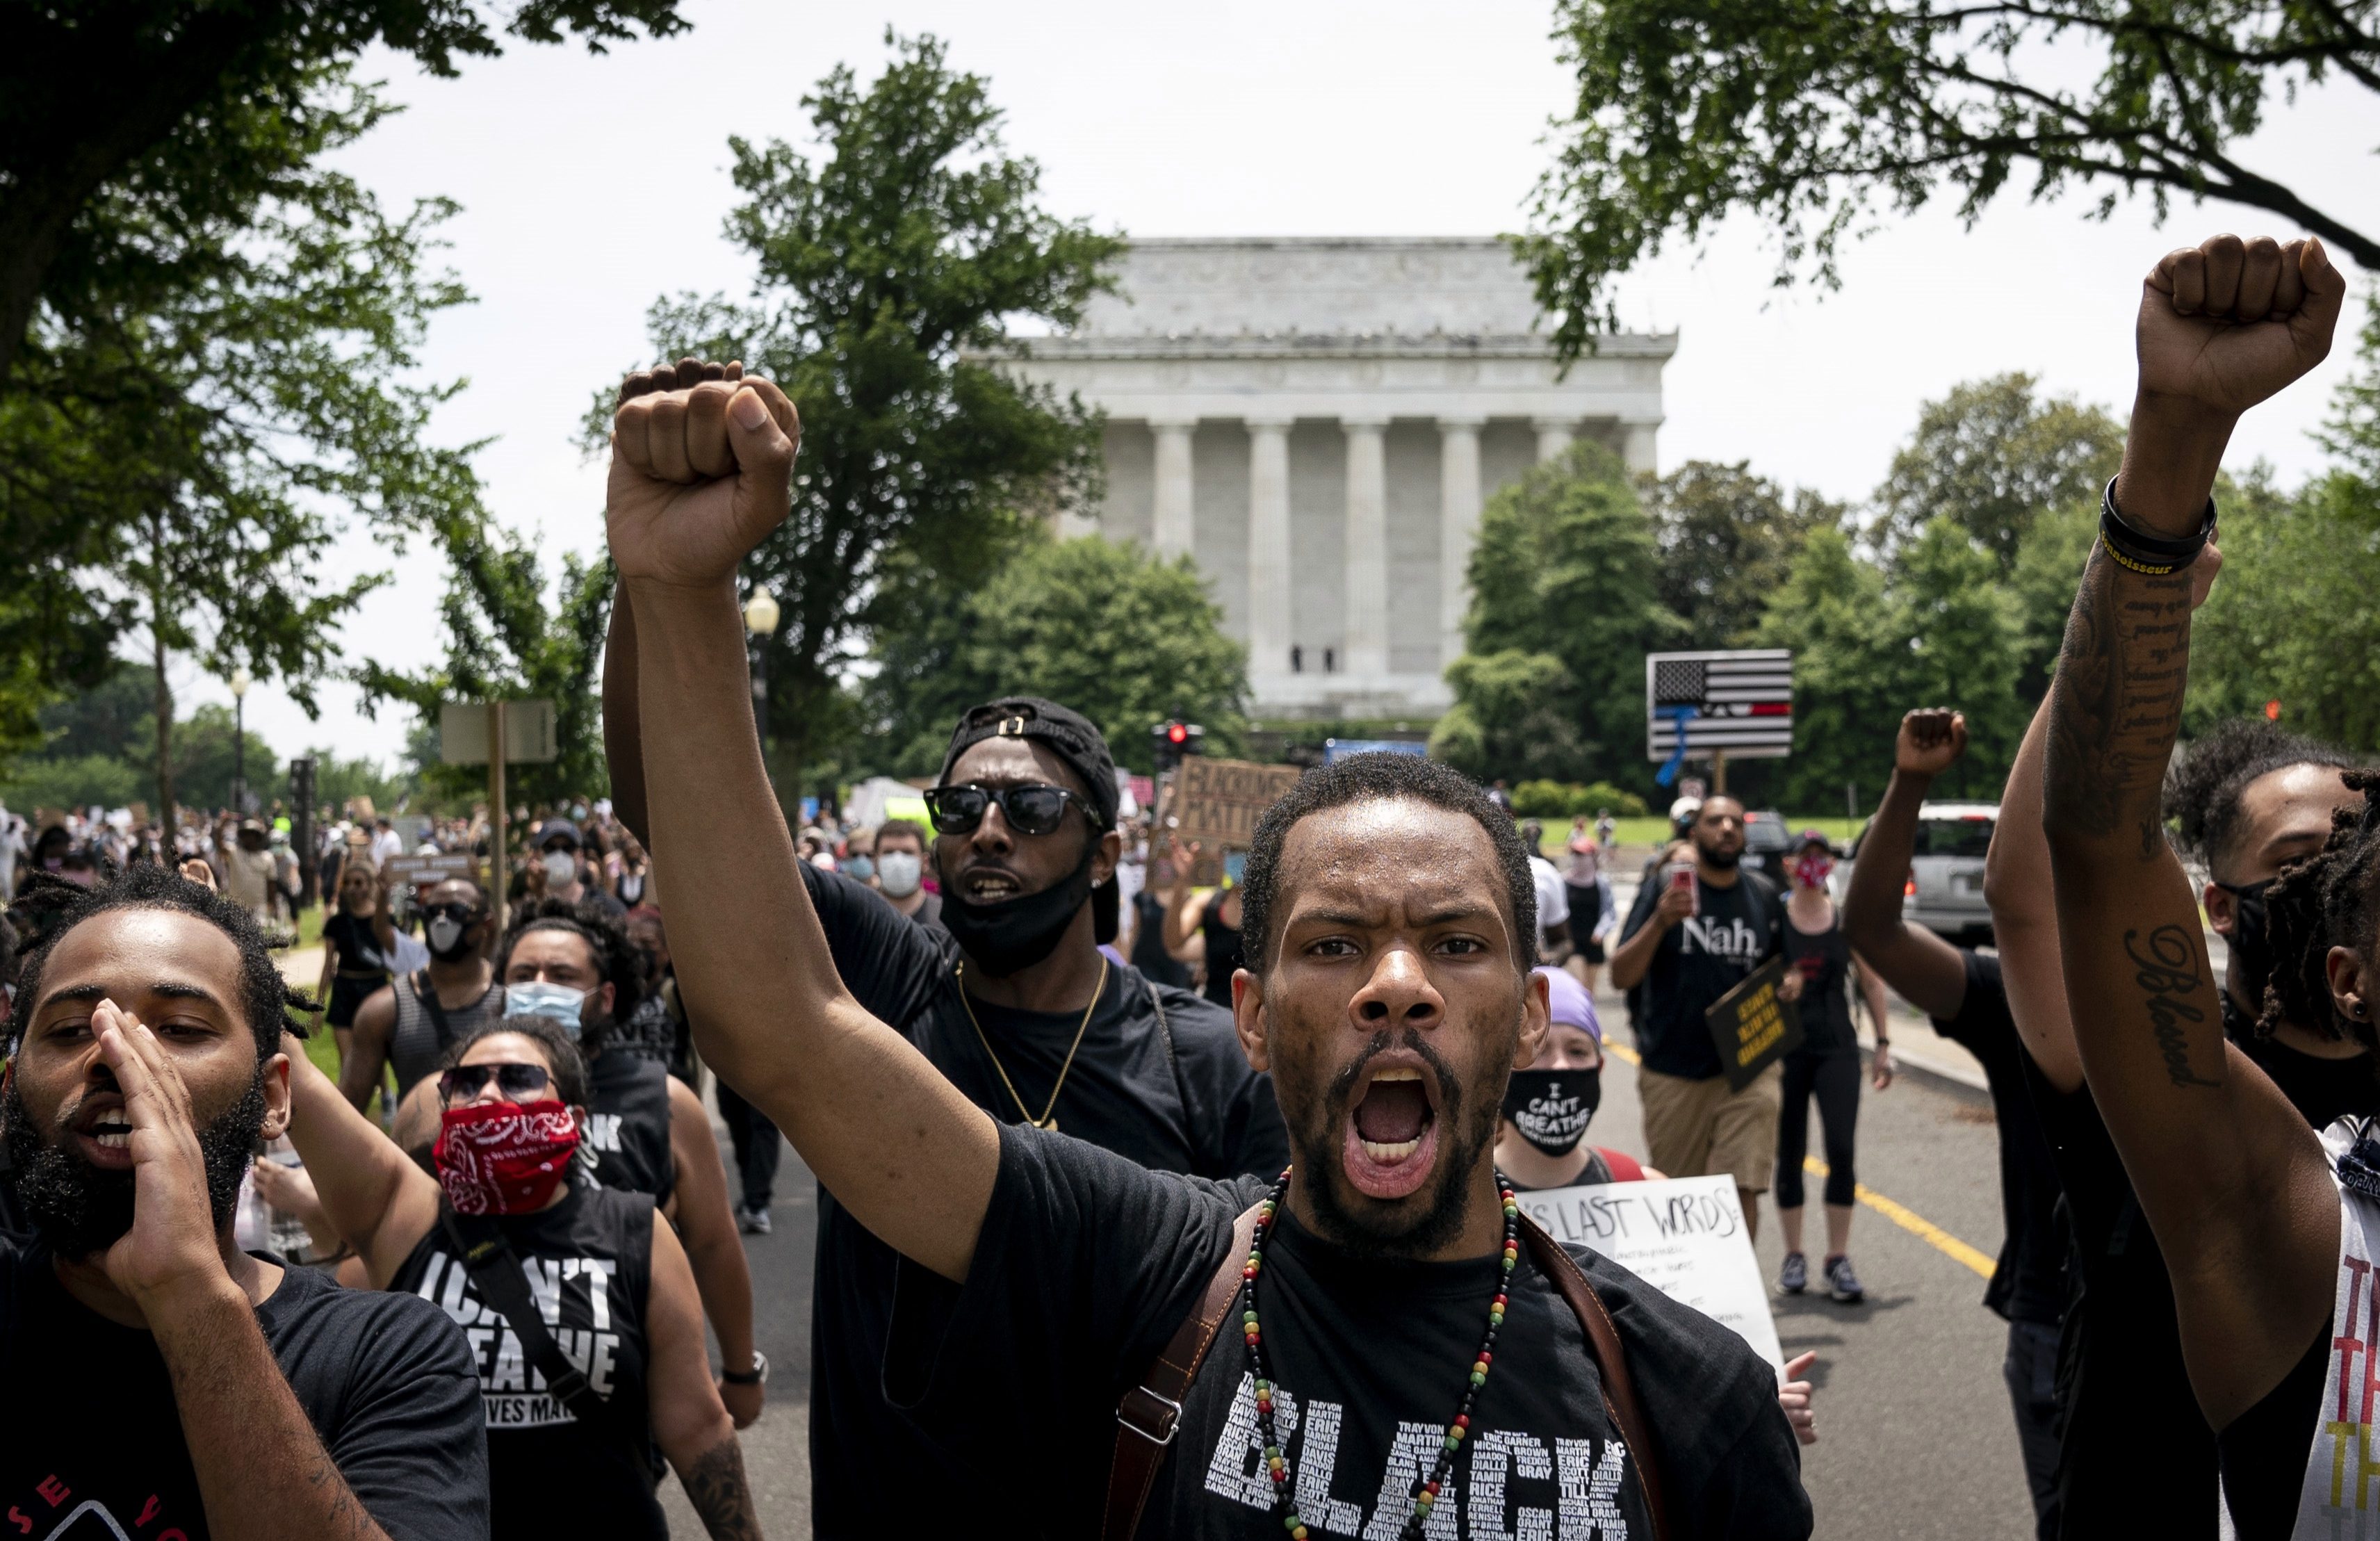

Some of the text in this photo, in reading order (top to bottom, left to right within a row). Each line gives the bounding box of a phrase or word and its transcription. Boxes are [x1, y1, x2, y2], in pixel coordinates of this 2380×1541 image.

[1549, 1082, 1562, 1099] I
[1529, 1096, 1581, 1117] CAN'T
[1516, 1107, 1590, 1134] BREATHE
[1556, 1196, 1633, 1241] LAST
[1309, 1399, 1342, 1412] TRAYVON
[1228, 1412, 1256, 1431] TAMIR
[1307, 1408, 1342, 1421] MARTIN
[1223, 1422, 1250, 1444] RICE
[1305, 1417, 1341, 1435] ERIC
[1399, 1421, 1444, 1435] TRAYVON
[1304, 1429, 1339, 1444] GARNER
[1396, 1432, 1445, 1448] MARTIN
[1483, 1432, 1502, 1443] ERIC
[1503, 1436, 1541, 1448] GARNER
[1555, 1437, 1590, 1448] TRAYVON
[1218, 1435, 1249, 1454] OSCAR
[1303, 1437, 1337, 1453] JORDAN
[1393, 1440, 1412, 1453] ERIC
[1474, 1440, 1549, 1458] MICHAEL BROWN
[1556, 1445, 1590, 1457] MARTIN
[1213, 1452, 1245, 1471] TRAYVON
[1216, 1445, 1248, 1463] GRANT
[1302, 1444, 1336, 1465] DAVIS
[1391, 1448, 1417, 1461] SANDRA
[1472, 1451, 1508, 1462] AMADOU
[1516, 1456, 1551, 1467] FREDDIE
[1209, 1460, 1242, 1479] MARTIN
[1387, 1456, 1416, 1469] BLAND
[1472, 1459, 1508, 1472] DIALLO
[1558, 1455, 1590, 1469] ERIC
[1298, 1462, 1332, 1482] DIALLO
[1386, 1466, 1418, 1480] KIMANI
[1469, 1470, 1506, 1484] TAMIR
[1517, 1464, 1553, 1481] GRAY
[1558, 1465, 1590, 1478] SCOTT
[1207, 1469, 1244, 1492] MICHAEL
[1246, 1484, 1279, 1504] BROWN
[1296, 1473, 1330, 1493] ERIC
[1384, 1475, 1414, 1490] GRAY
[1204, 1479, 1271, 1512] SANDRA BLAND
[1295, 1485, 1328, 1502] SCOTT
[1381, 1484, 1410, 1499] OSCAR
[1469, 1482, 1505, 1499] RICE
[1559, 1481, 1590, 1501] TILL
[1467, 1503, 1505, 1515] FERRELL
[1517, 1506, 1553, 1520] OSCAR
[1558, 1505, 1621, 1519] OSCAR GRANT
[1467, 1512, 1503, 1523] RENISHA
[1517, 1517, 1553, 1530] GRANT
[1558, 1515, 1627, 1530] TRAYVON TAMIR
[1326, 1519, 1359, 1538] GRANT
[1367, 1519, 1403, 1535] JORDAN
[1517, 1528, 1554, 1541] ERIC
[1468, 1529, 1515, 1541] JONATHAN
